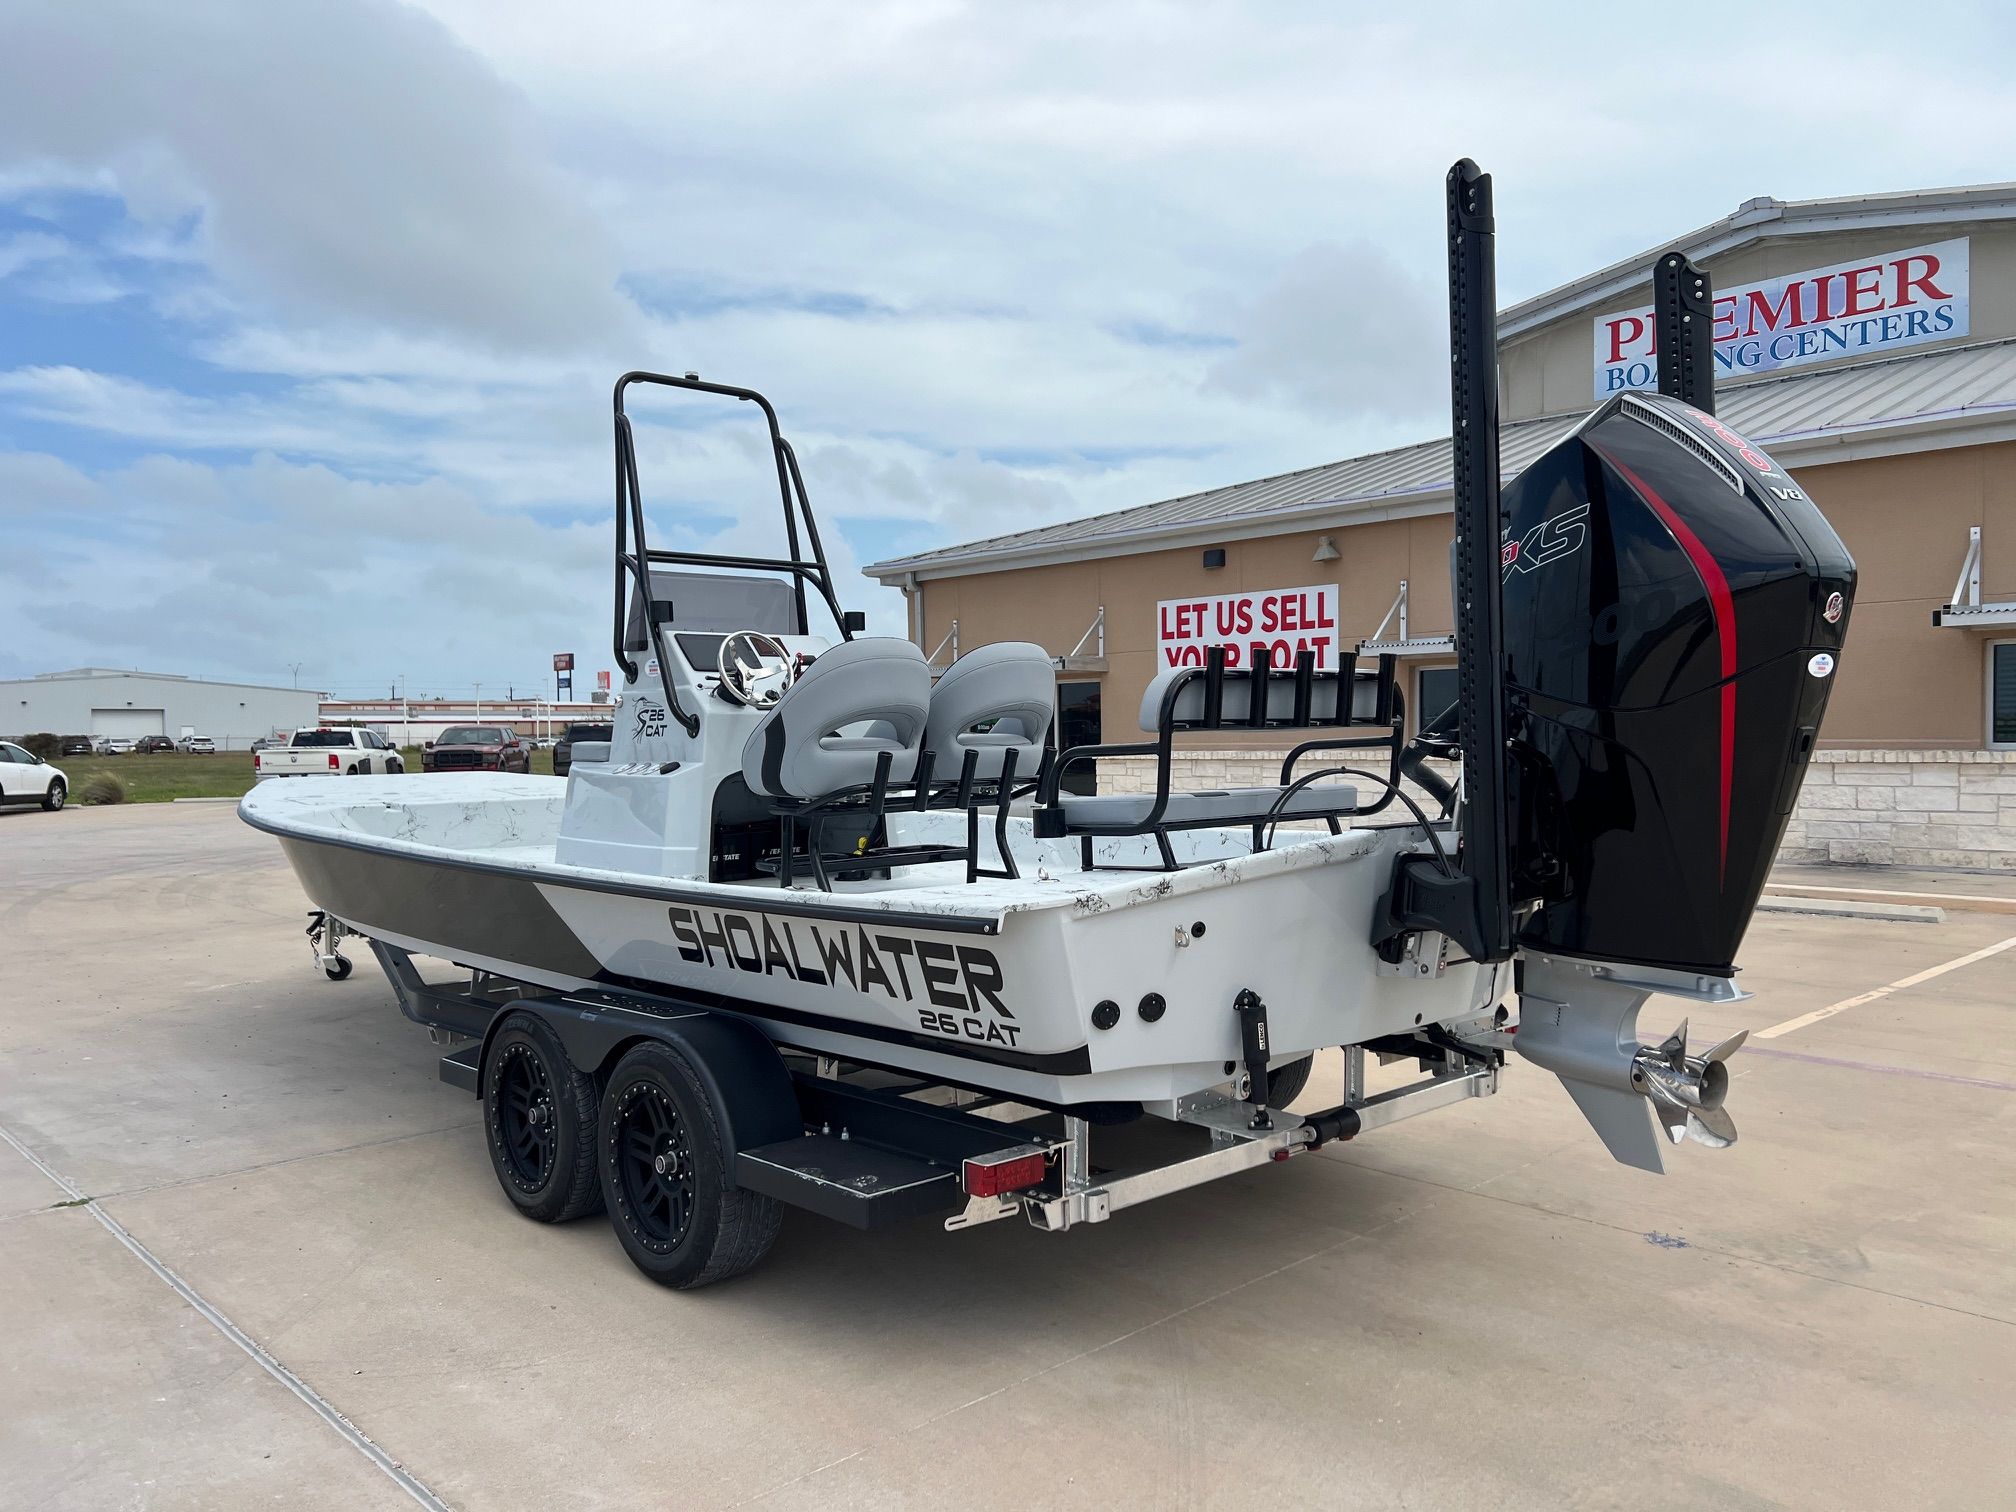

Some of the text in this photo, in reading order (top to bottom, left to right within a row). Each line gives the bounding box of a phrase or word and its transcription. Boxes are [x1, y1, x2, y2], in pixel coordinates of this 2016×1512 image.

[1605, 303, 1954, 391] BONG CENTERS
[1769, 486, 1804, 501] V8
[1161, 591, 1334, 640] LET US SELL
[645, 723, 668, 737] CAT
[649, 709, 665, 722] 26
[668, 907, 1015, 1019] SHOALWATER
[918, 1009, 1021, 1047] 26 CAT
